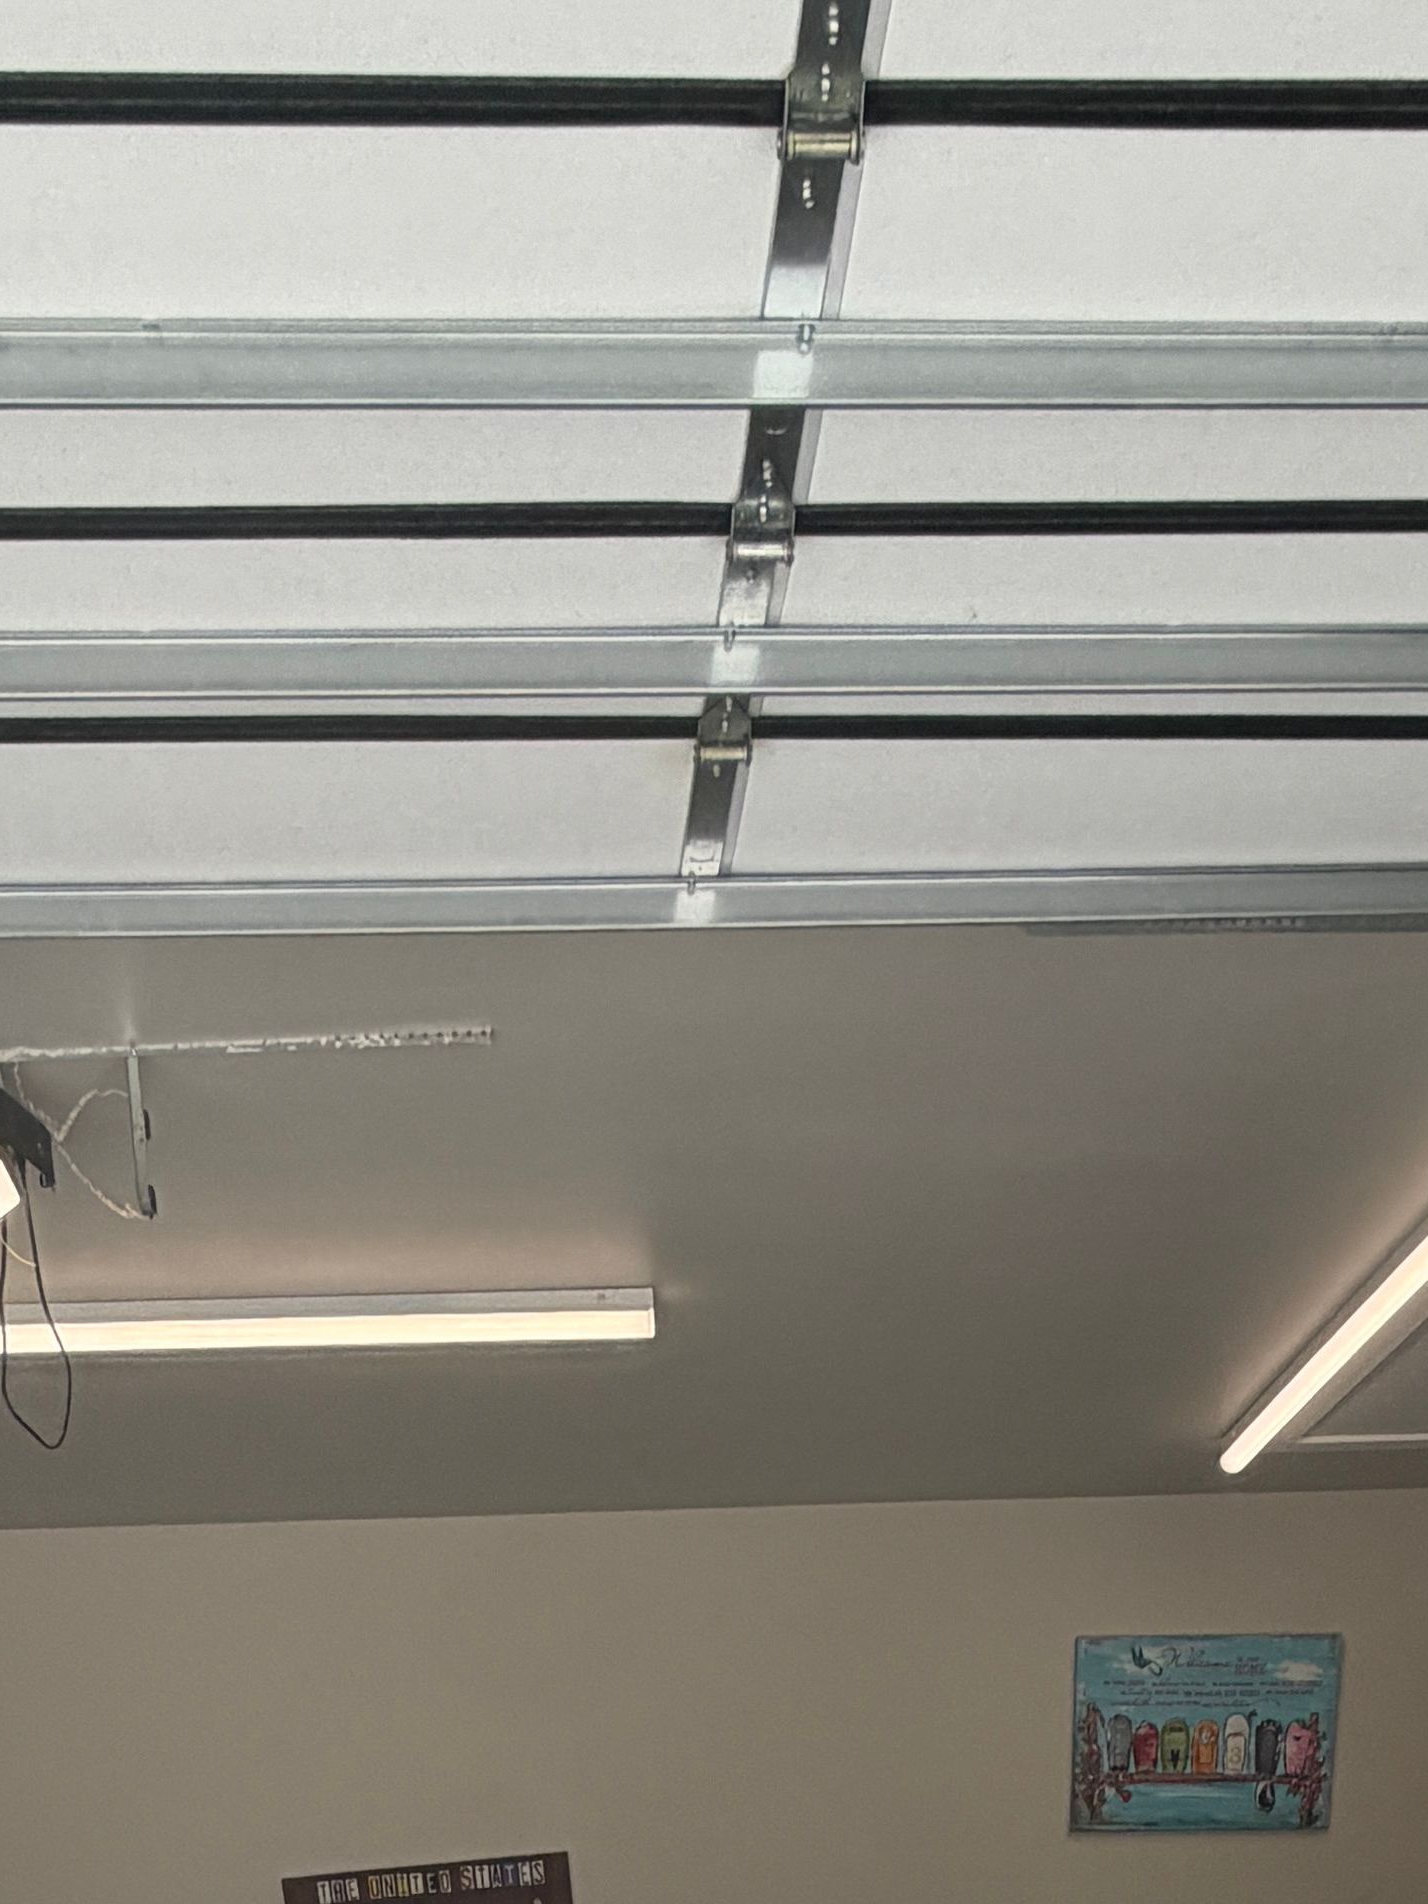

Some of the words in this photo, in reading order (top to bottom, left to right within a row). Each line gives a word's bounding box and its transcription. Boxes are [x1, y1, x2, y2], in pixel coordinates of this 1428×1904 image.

[317, 1878, 360, 1904] THE
[368, 1869, 452, 1900] UNITED
[460, 1860, 546, 1891] STATES
